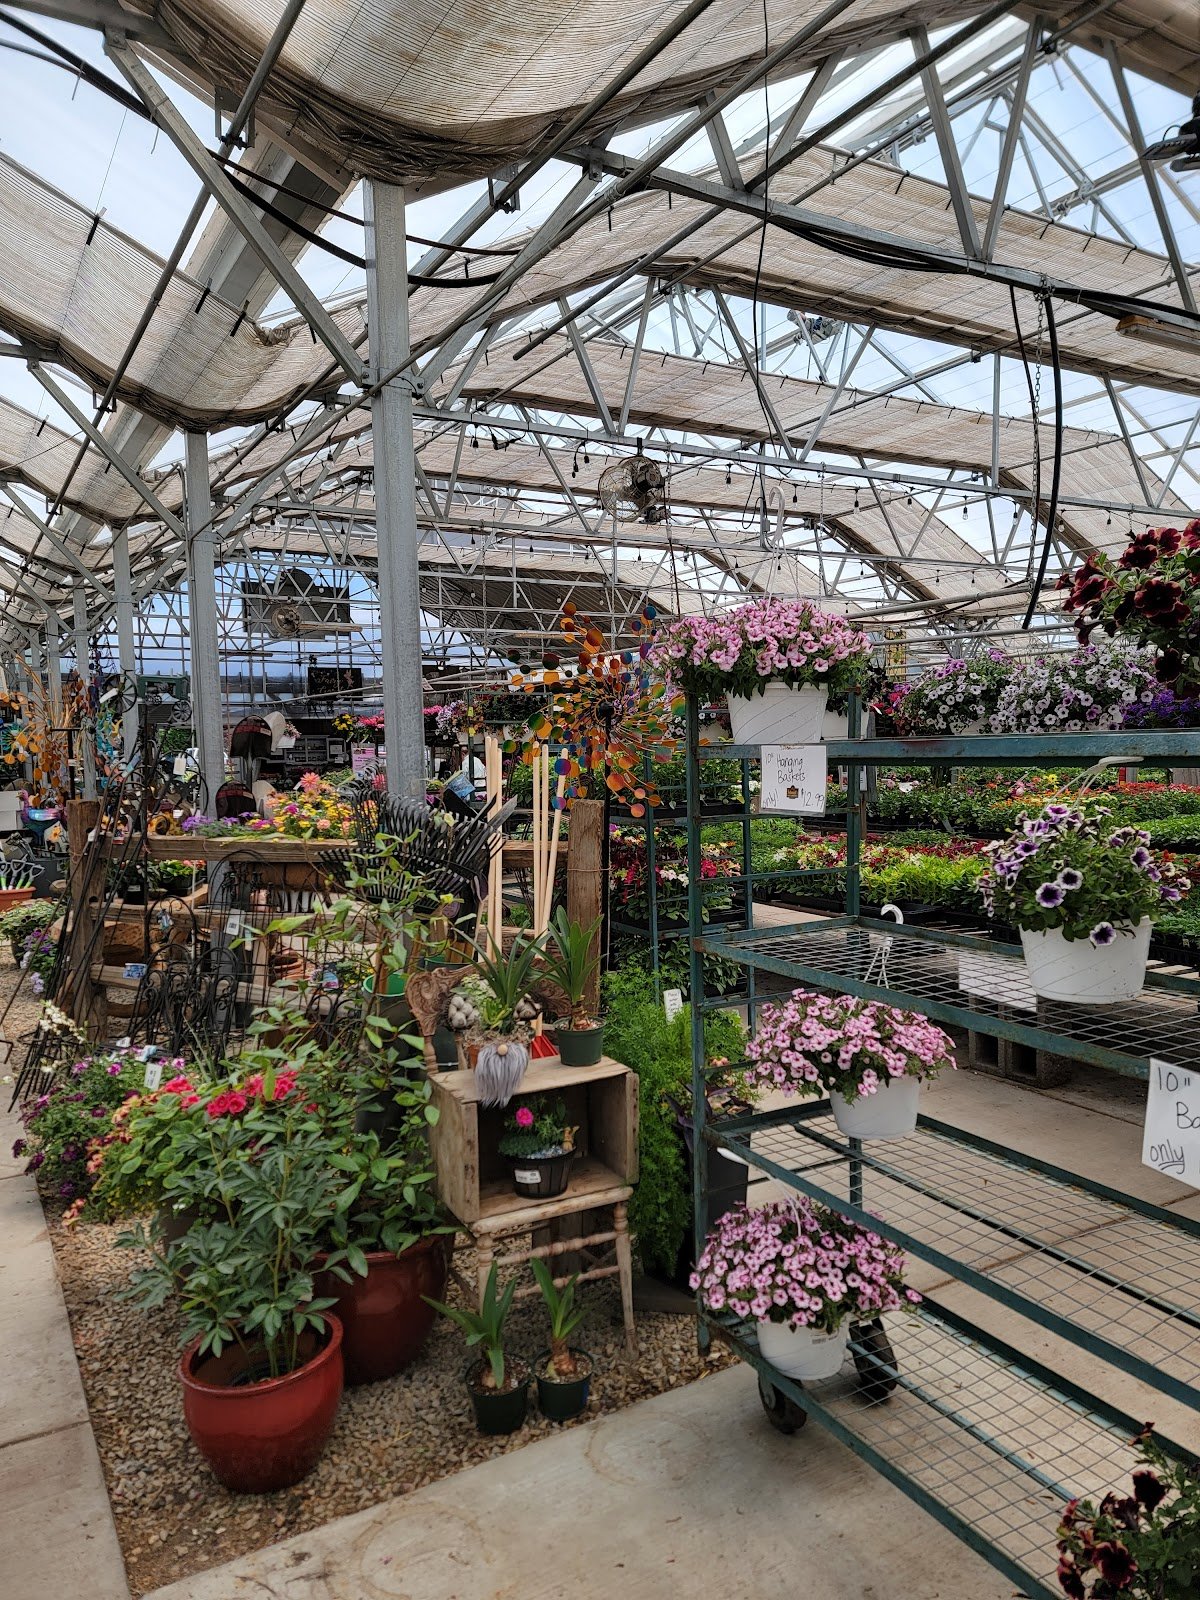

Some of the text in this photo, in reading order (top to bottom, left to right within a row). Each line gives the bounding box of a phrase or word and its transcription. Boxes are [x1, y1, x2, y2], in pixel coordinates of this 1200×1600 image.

[777, 753, 804, 773] Hanging
[777, 769, 806, 784] Baskets
[801, 787, 825, 810] $12.99
[1157, 1066, 1191, 1092] 10"
[1150, 1138, 1185, 1174] only
